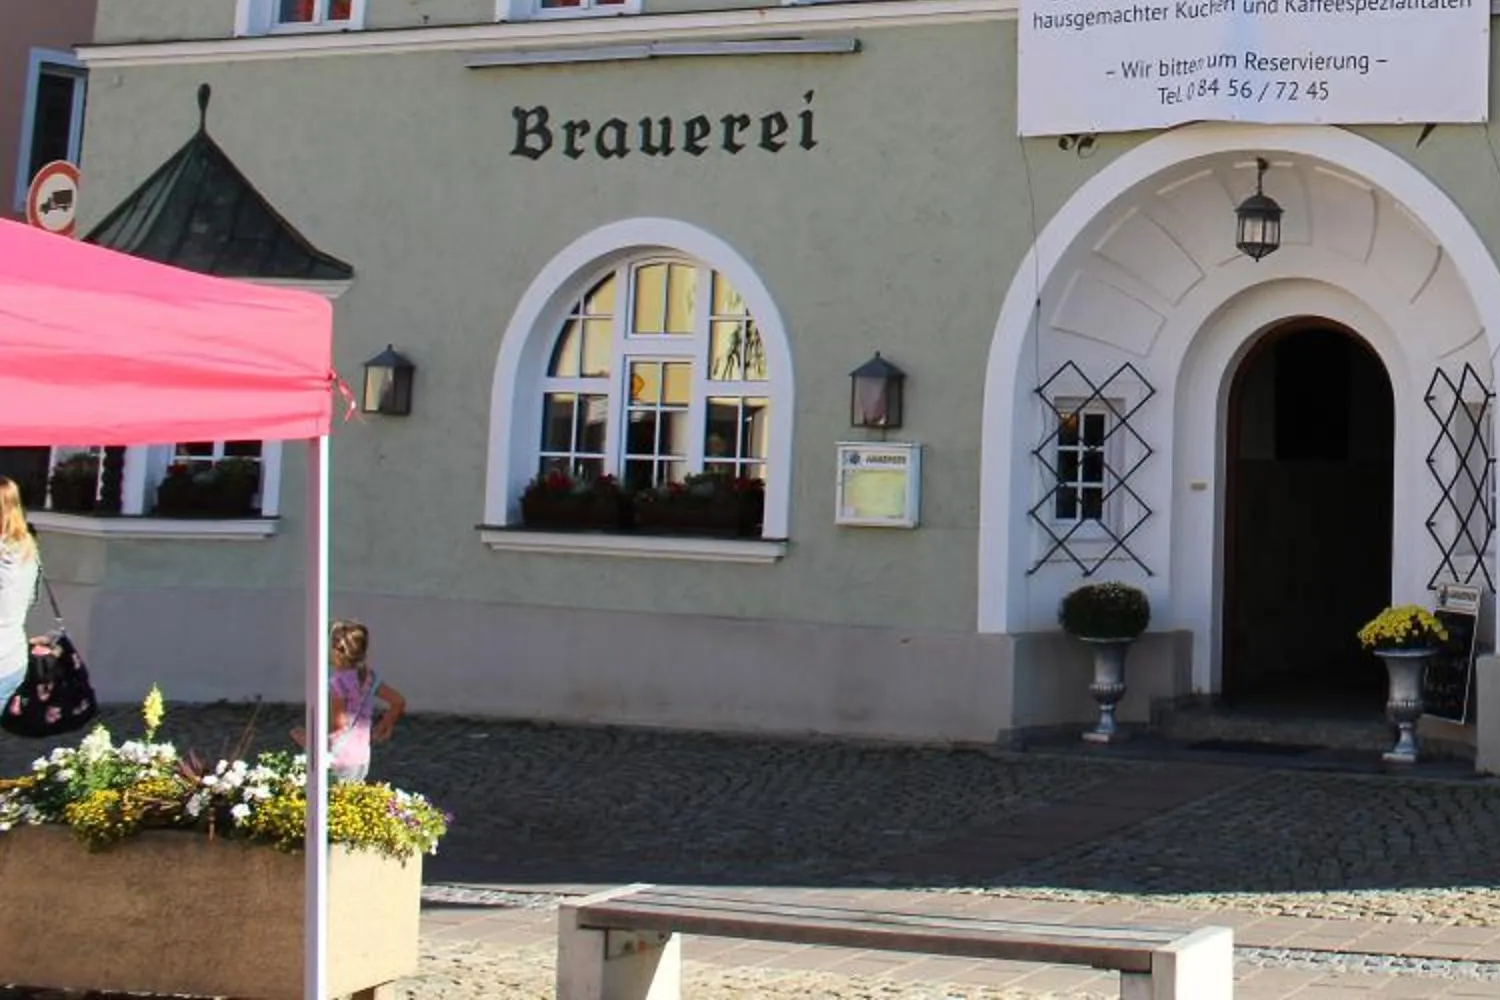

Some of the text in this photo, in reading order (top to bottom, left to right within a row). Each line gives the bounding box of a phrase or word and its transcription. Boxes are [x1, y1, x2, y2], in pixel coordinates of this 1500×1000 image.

[1033, 4, 1169, 31] hausgemachter
[1121, 60, 1153, 79] Wir
[1206, 53, 1237, 69] um
[1244, 51, 1369, 75] Reservierung
[1227, 78, 1253, 99] 56
[1275, 80, 1299, 101] 72
[1305, 80, 1329, 101] 45
[509, 89, 818, 161] Brauerei
